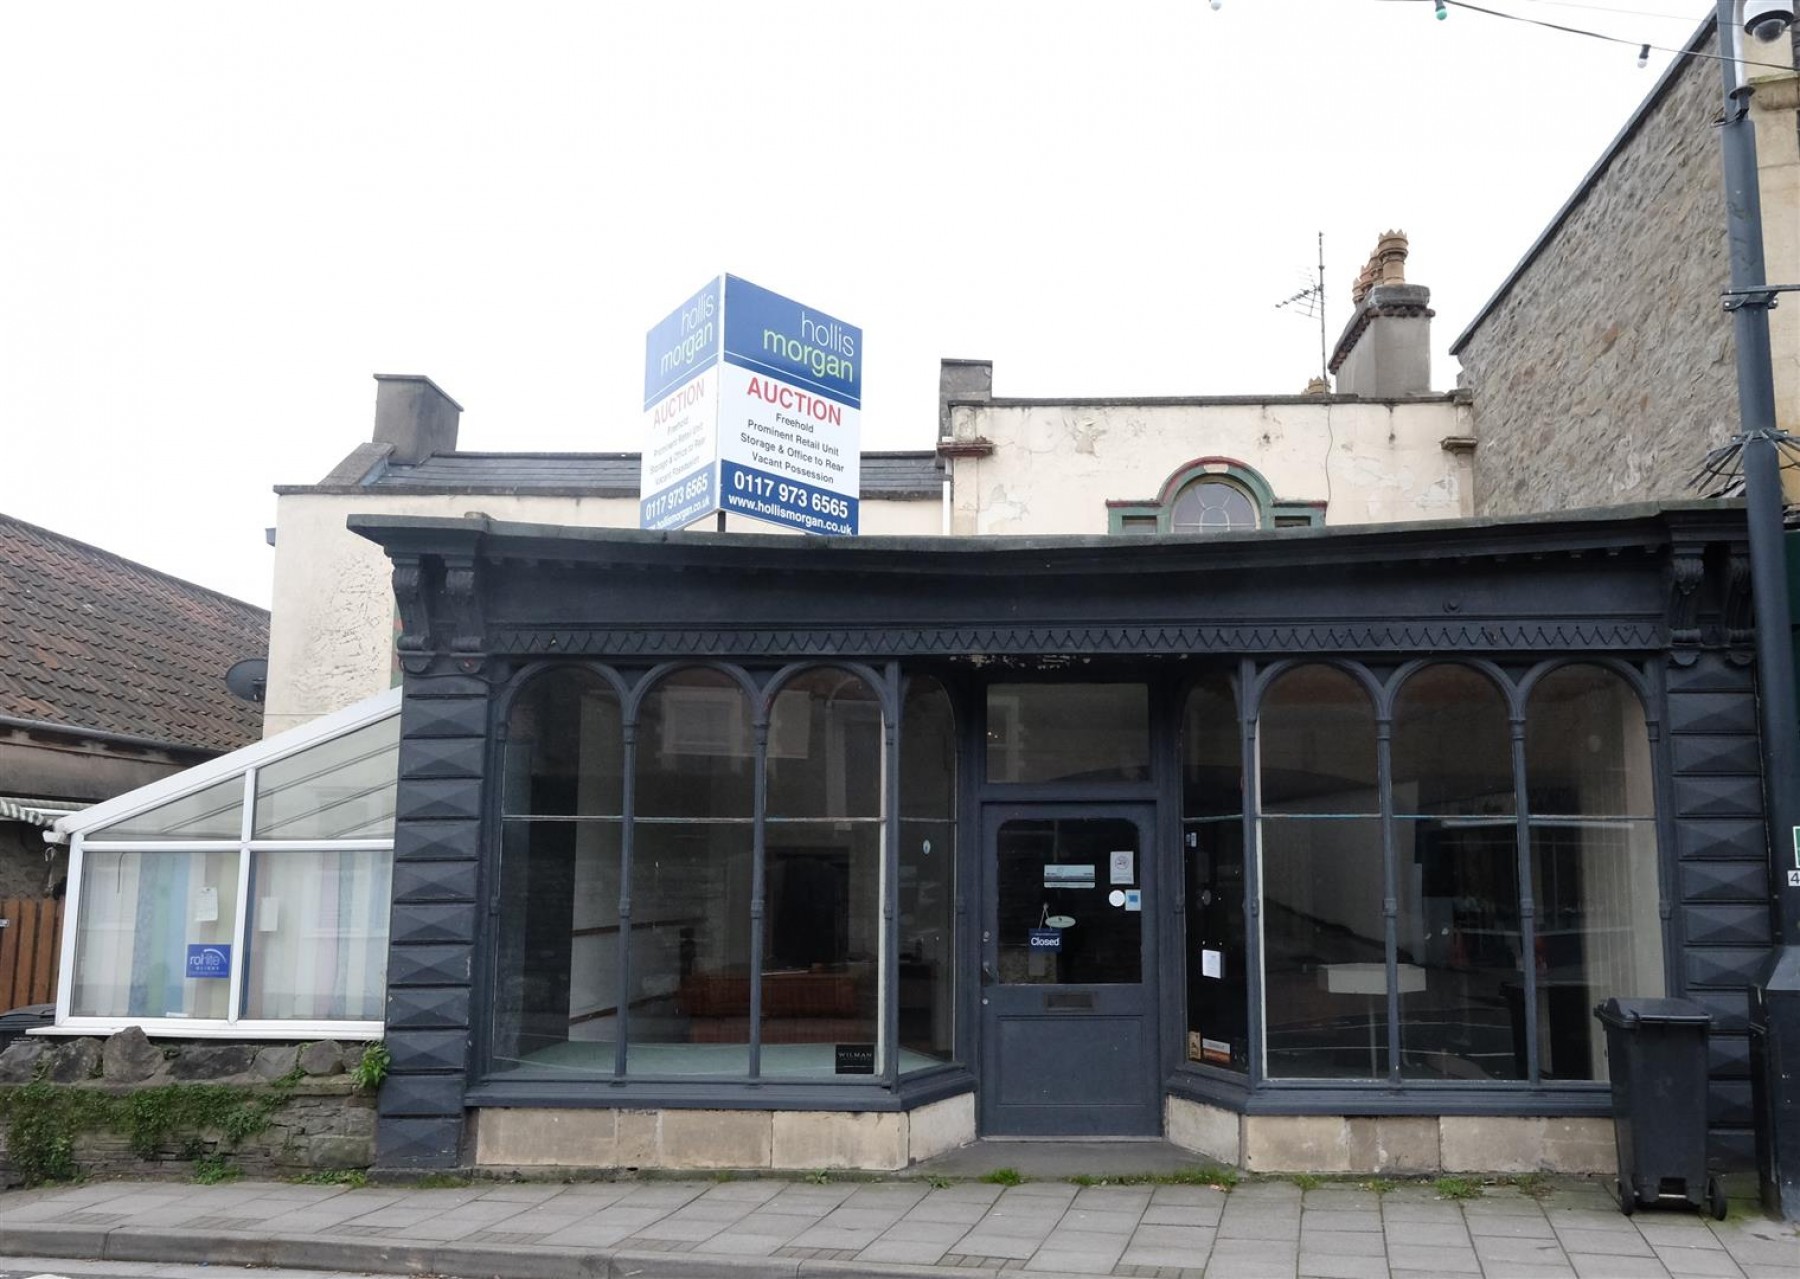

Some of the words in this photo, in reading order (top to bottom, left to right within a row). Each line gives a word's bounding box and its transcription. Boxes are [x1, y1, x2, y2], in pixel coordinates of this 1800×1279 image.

[681, 293, 714, 337] hollis
[801, 309, 854, 357] hollis
[660, 321, 713, 377] morgan
[763, 328, 853, 383] morgan
[652, 378, 705, 429] AUCTION
[747, 376, 842, 426] AUCTION
[775, 412, 814, 434] Freehold
[740, 432, 776, 452] Storage
[778, 444, 784, 454] &
[787, 446, 813, 462] Office
[814, 456, 823, 466] to
[825, 458, 845, 472] Rear
[748, 418, 793, 442] Prominent
[795, 434, 820, 450] Retail
[822, 442, 839, 457] Unit
[751, 450, 782, 469] Vacant
[785, 460, 834, 484] Possession
[645, 494, 667, 521] 0117
[667, 485, 685, 509] 973
[685, 472, 708, 500] 6565
[728, 494, 853, 535] www.hollismorgan.co.uk
[734, 470, 774, 497] 0117
[778, 483, 808, 507] 973
[811, 492, 849, 519] 6565
[1030, 936, 1060, 946] Closed
